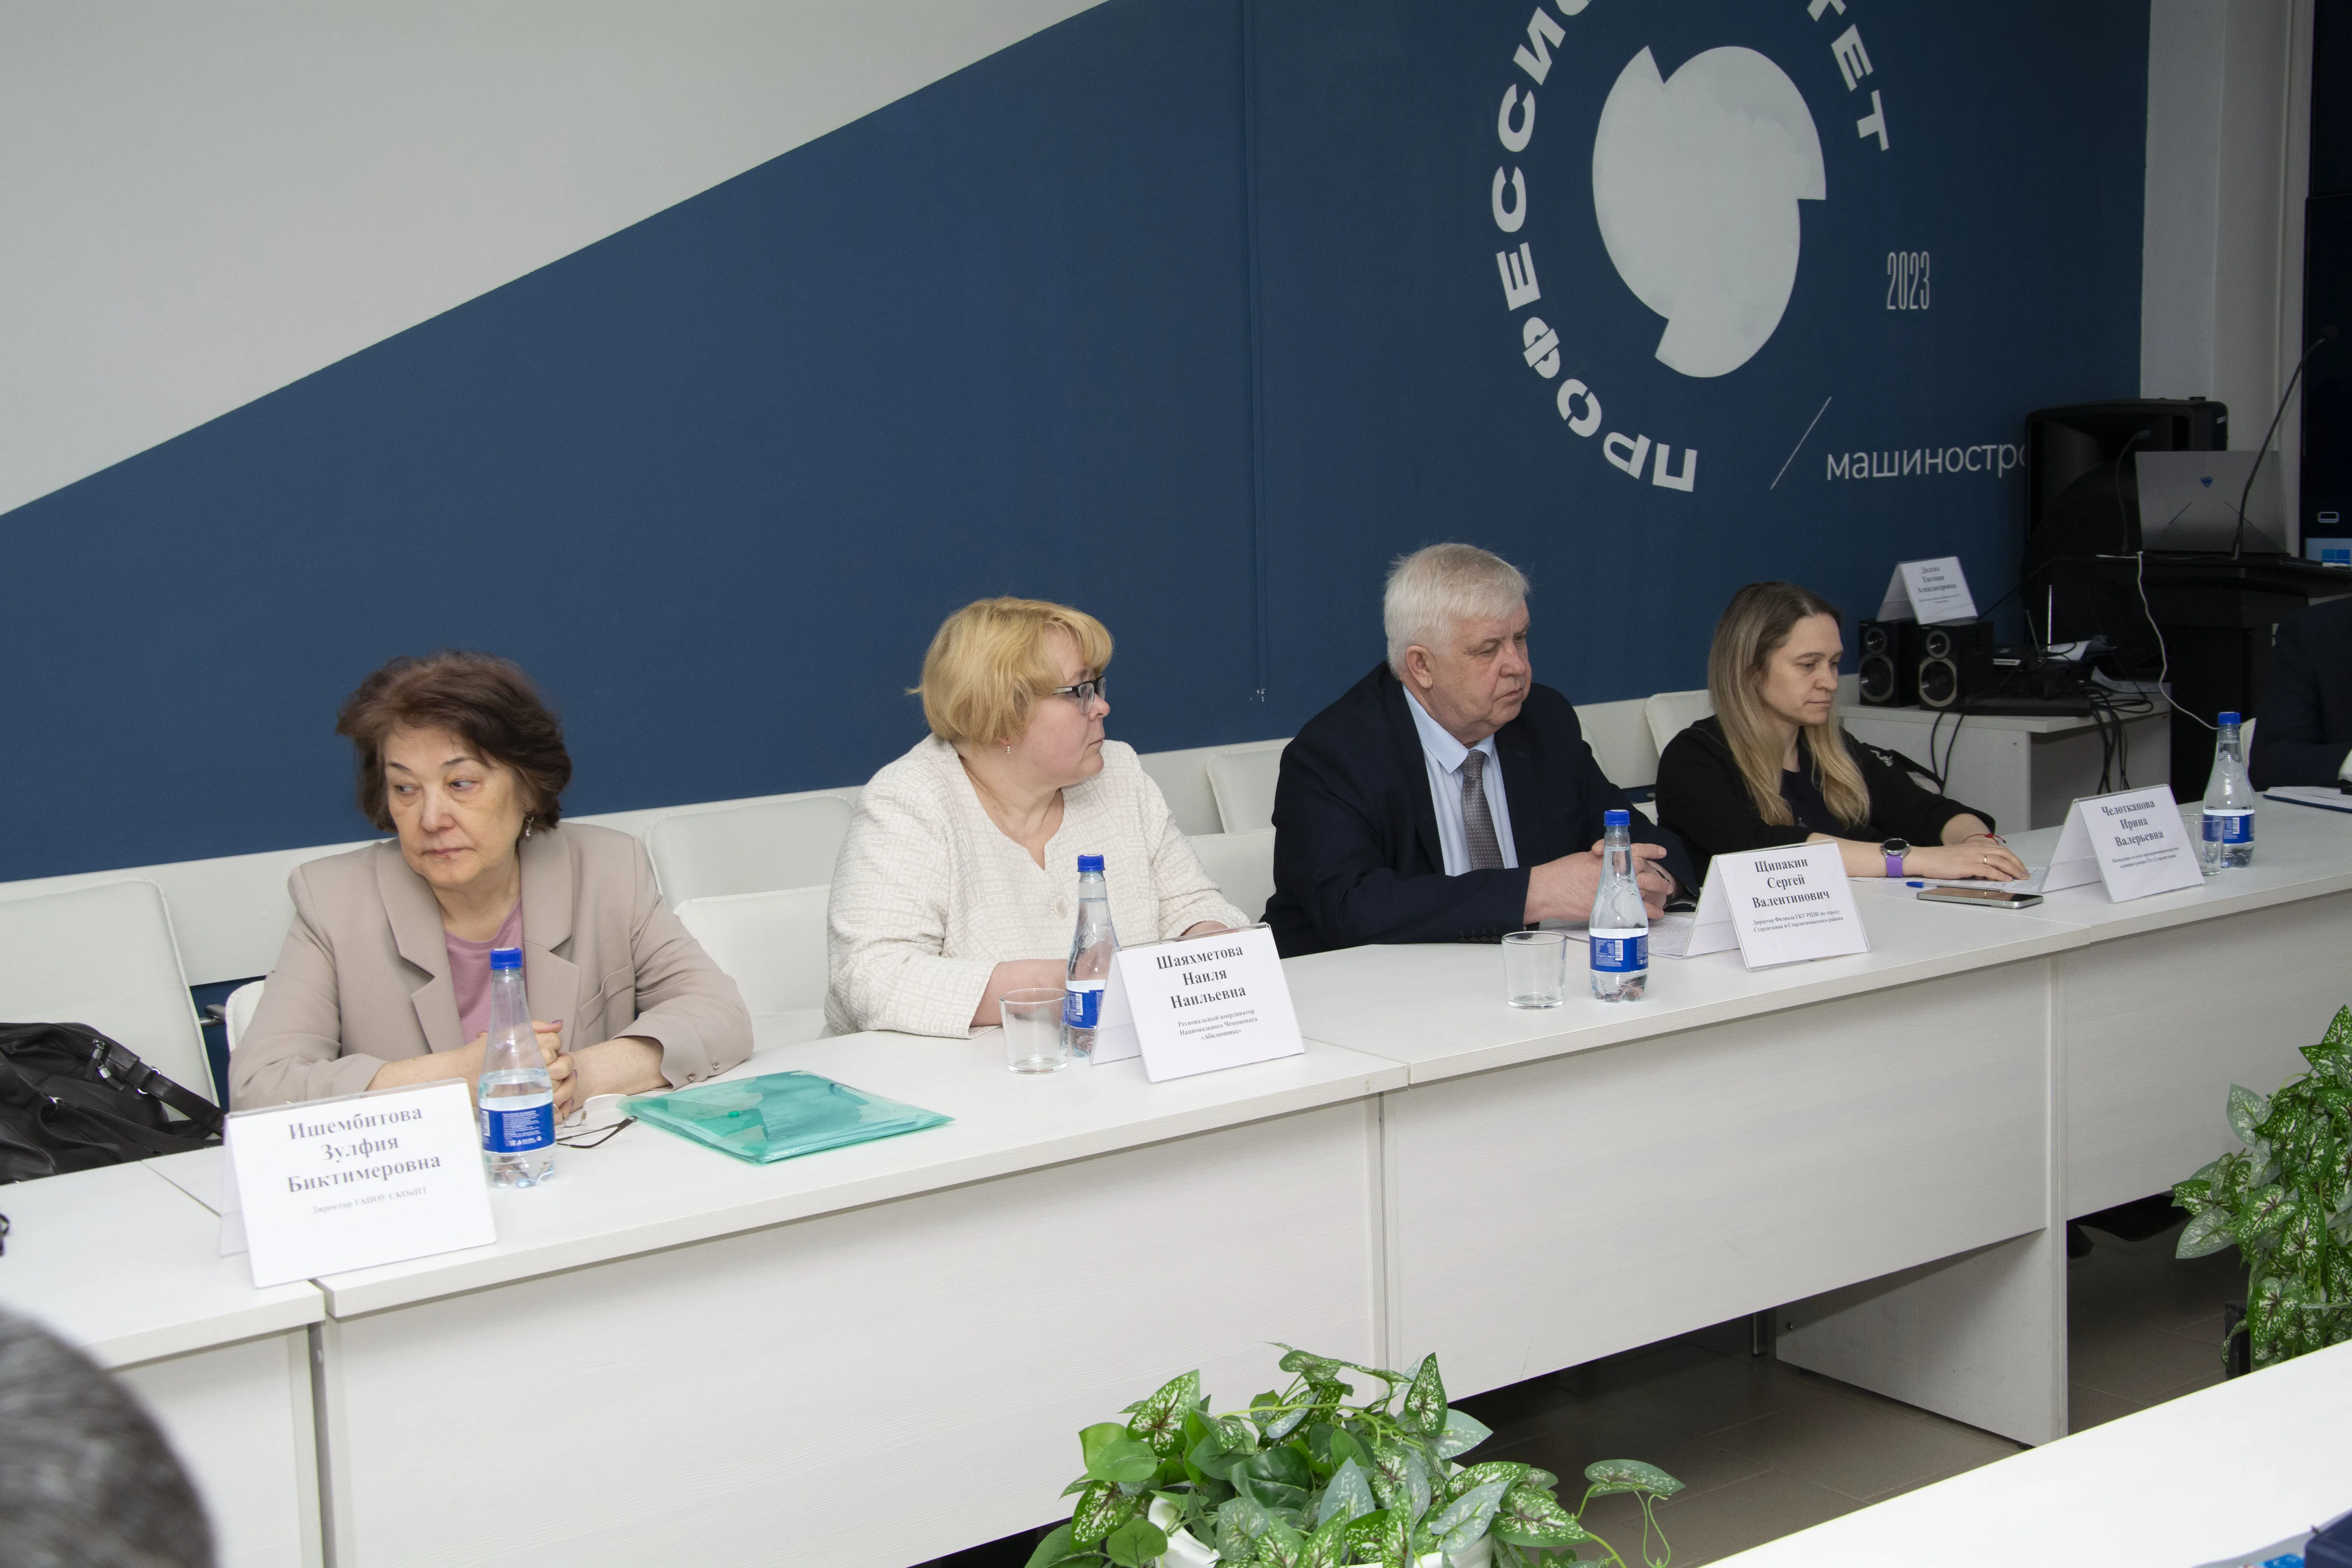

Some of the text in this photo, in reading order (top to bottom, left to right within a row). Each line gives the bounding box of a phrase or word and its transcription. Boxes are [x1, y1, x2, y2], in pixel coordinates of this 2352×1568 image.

[1887, 251, 1929, 310] 2023
[2101, 800, 2155, 816] Челотканова
[2120, 818, 2148, 831] Ирина
[2114, 831, 2164, 847] Валерьевна
[1754, 859, 1809, 873] Щипакин
[1767, 874, 1806, 890] Сергей
[1752, 891, 1830, 908] Валентинович
[1754, 925, 1783, 933] Стерлитамак
[1788, 919, 1828, 928] Стерлитамакского
[1156, 946, 1243, 969] Шаяхметова
[1182, 970, 1227, 986] Наиля
[1170, 987, 1247, 1009] Наильевна
[1178, 1009, 1255, 1027] Региональный координатор
[1180, 1017, 1258, 1036] Национального Чемпионата
[1201, 1029, 1241, 1040] «Абилимпикс»
[288, 1108, 423, 1140] Ишембитова
[321, 1138, 399, 1163] Зулфия
[288, 1156, 441, 1193] Биктимеровна
[312, 1201, 353, 1214] Директор
[354, 1194, 386, 1206] ГАПОУ
